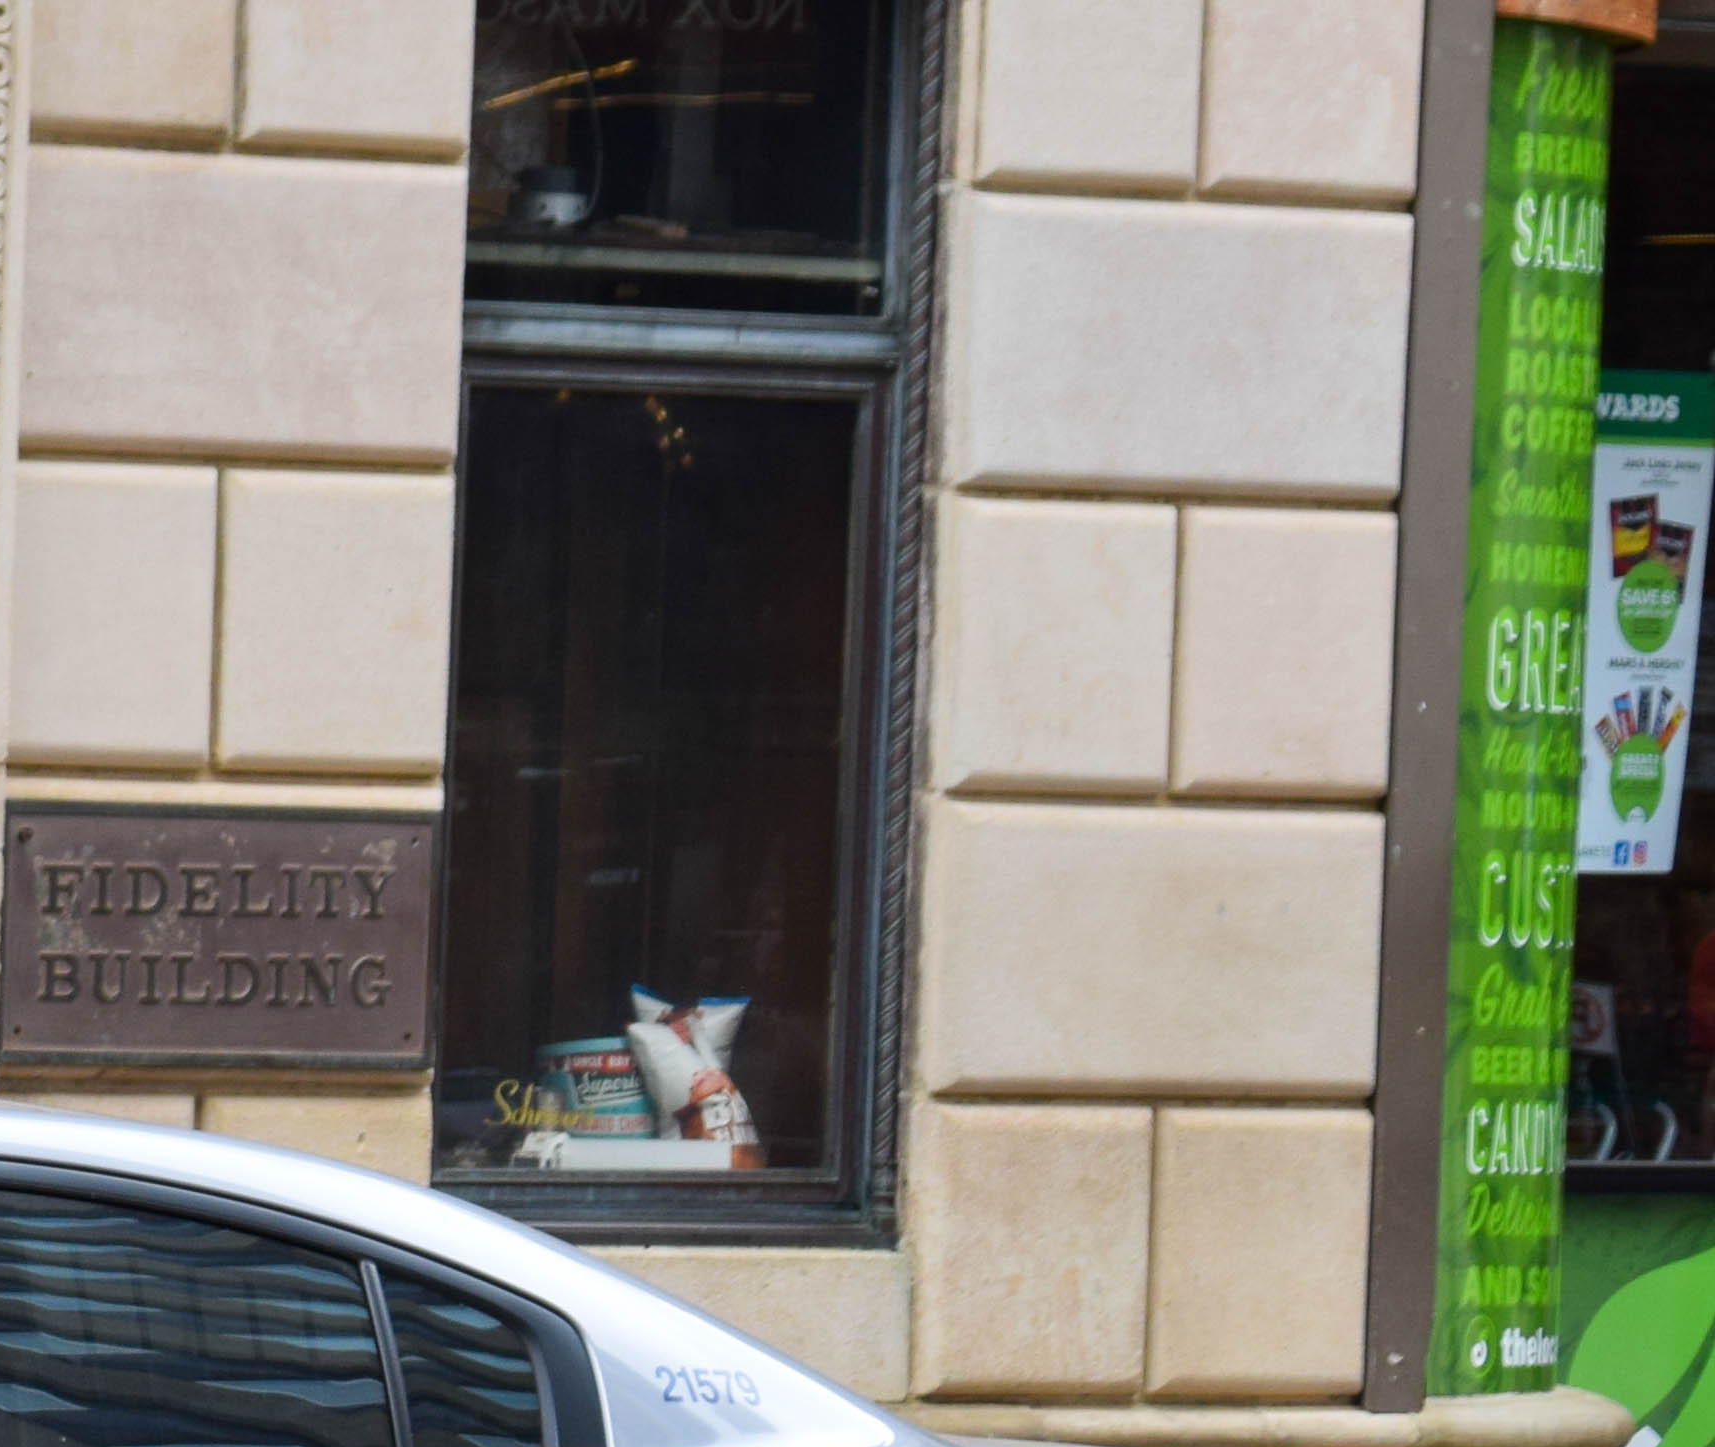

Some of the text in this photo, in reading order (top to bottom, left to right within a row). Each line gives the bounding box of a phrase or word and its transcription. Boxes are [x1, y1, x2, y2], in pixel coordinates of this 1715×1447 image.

[40, 861, 397, 919] FIDELITY
[37, 949, 394, 1009] BUILDING
[655, 1366, 761, 1406] 21579
